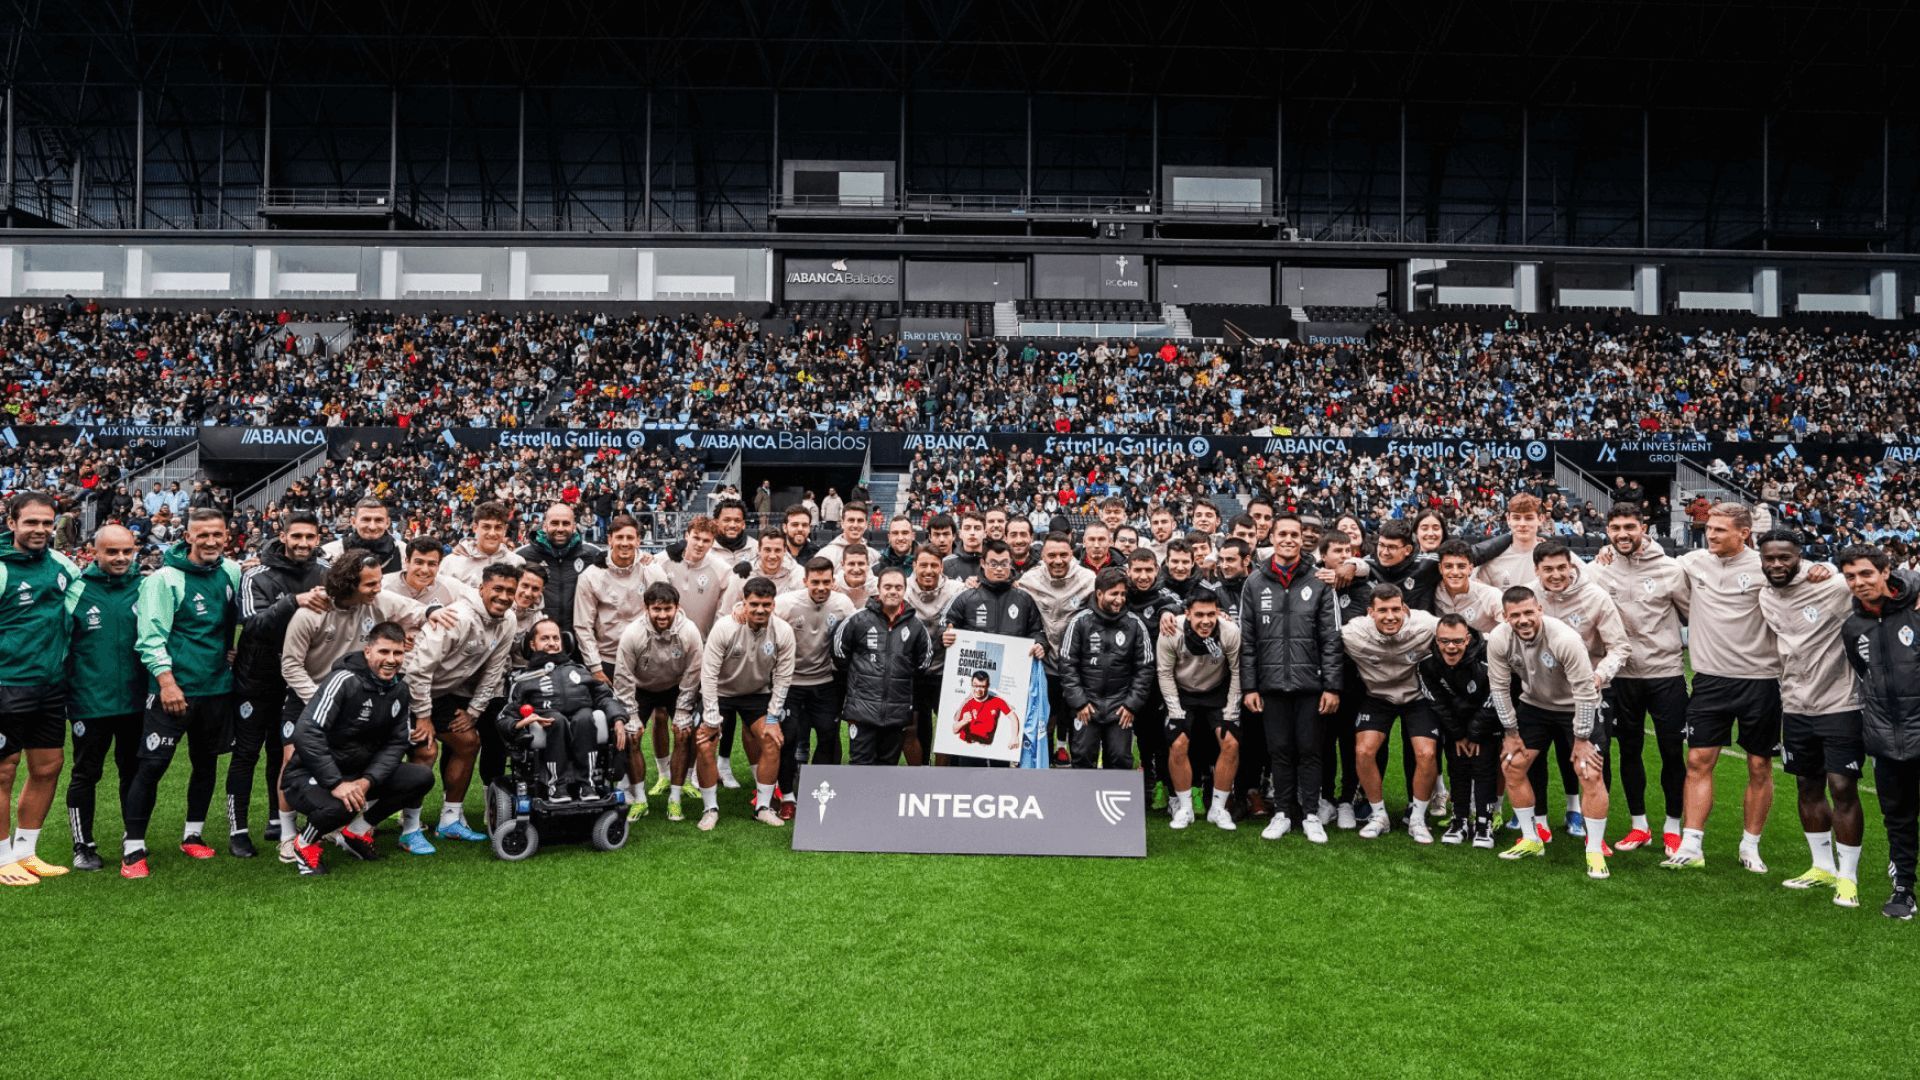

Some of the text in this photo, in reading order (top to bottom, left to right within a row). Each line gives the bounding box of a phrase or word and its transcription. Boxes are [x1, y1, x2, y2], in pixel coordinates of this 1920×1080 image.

[99, 426, 197, 436] AIX INVESTMENT
[128, 439, 167, 448] GUP
[500, 430, 623, 448] Estrella Galicia
[778, 431, 866, 449] Balaídos
[1620, 442, 1713, 451] AIX INVESTMENT
[959, 648, 988, 660] SAMUEL
[958, 657, 997, 671] COMESAÑA
[898, 793, 1044, 820] INTEGRA
